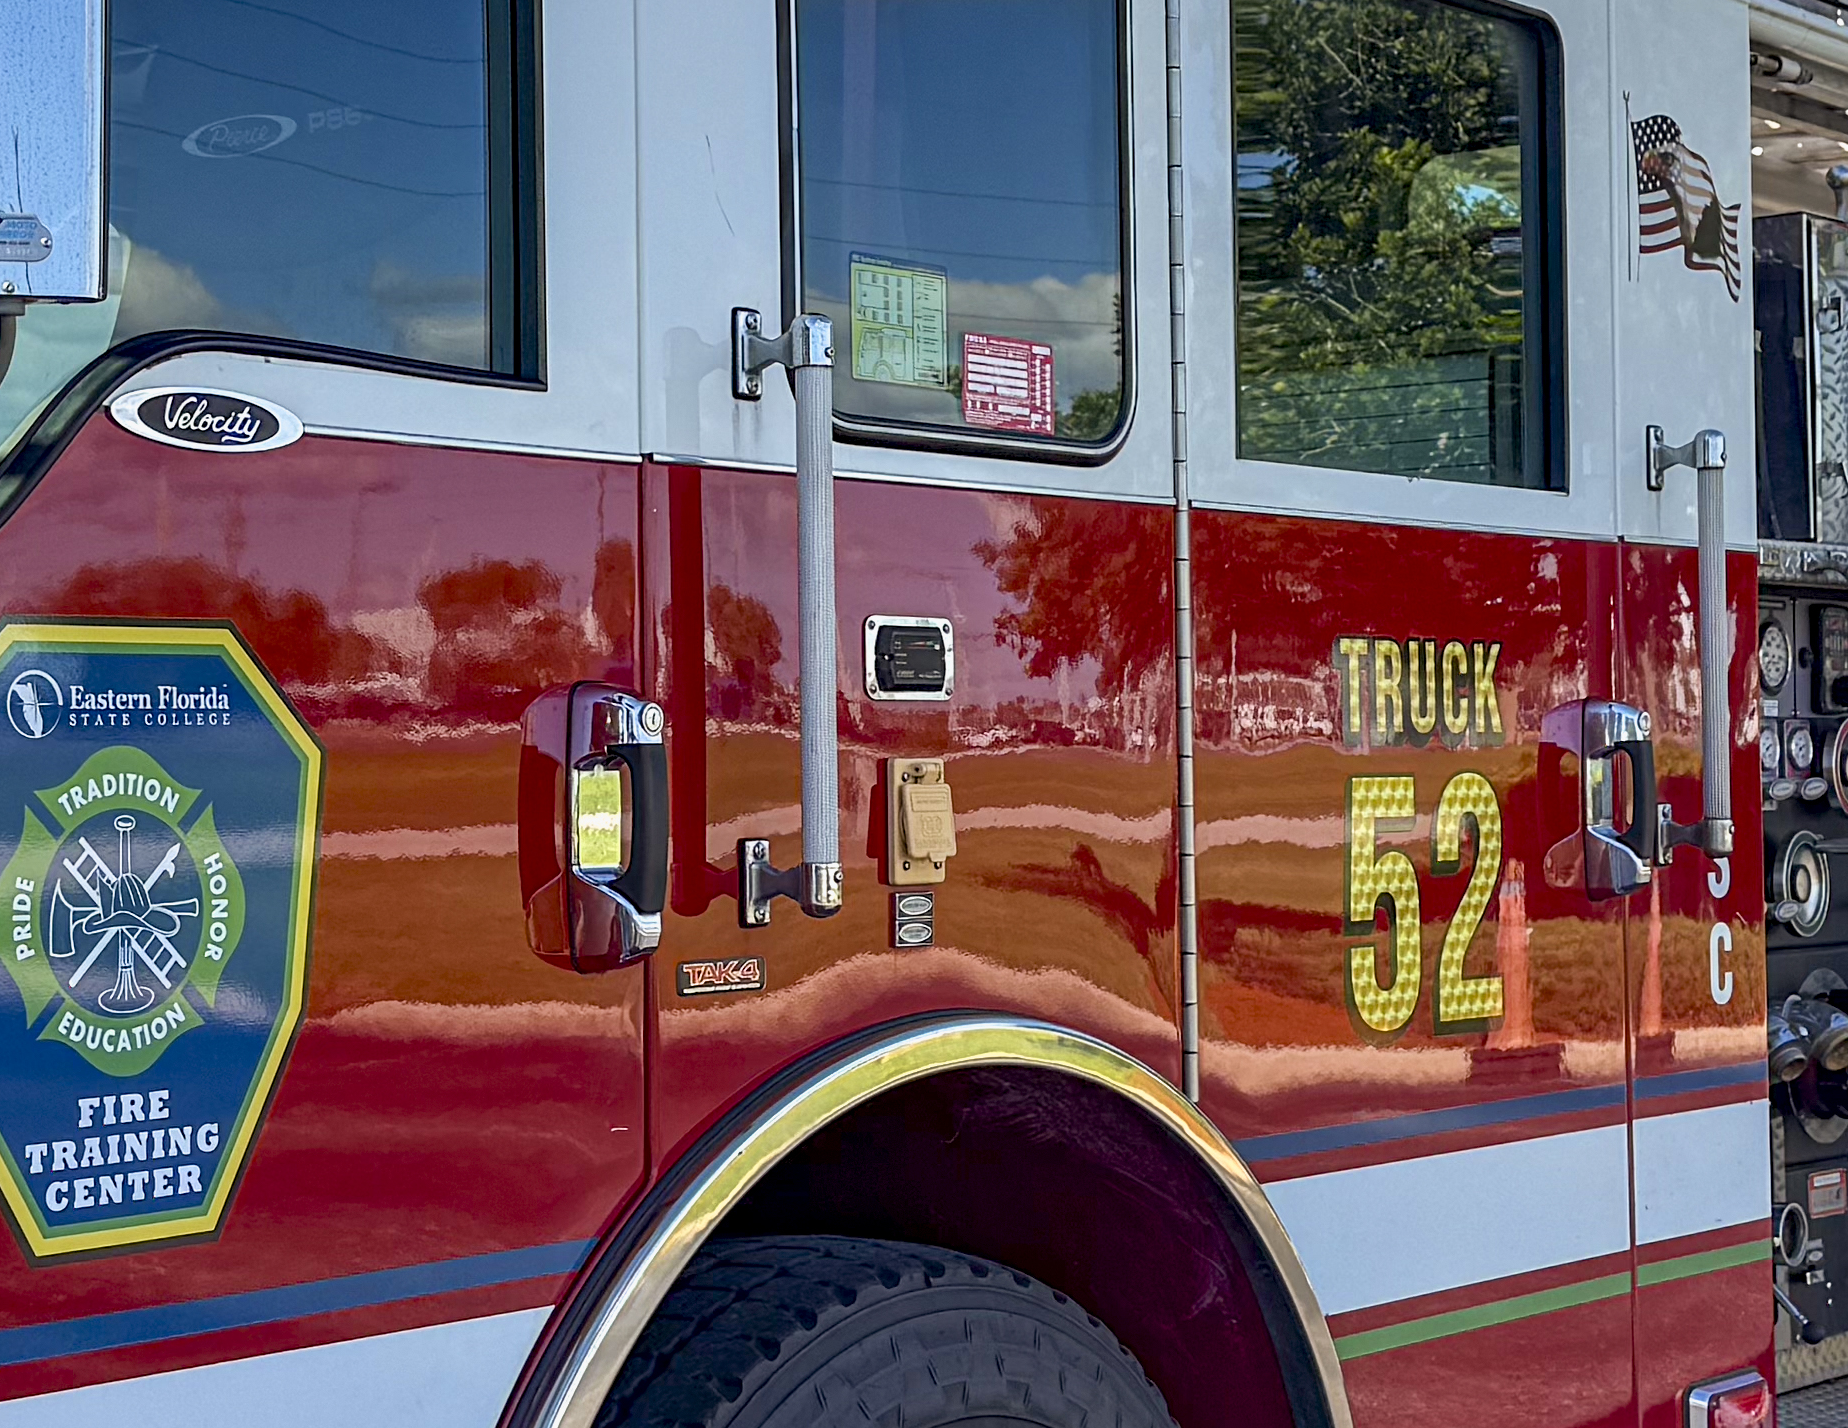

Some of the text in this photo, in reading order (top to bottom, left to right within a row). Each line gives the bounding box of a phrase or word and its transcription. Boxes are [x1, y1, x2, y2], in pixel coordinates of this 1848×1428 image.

[164, 395, 261, 443] Velocity
[69, 684, 230, 711] Eastern Florida
[1338, 637, 1504, 736] TRUCK
[69, 712, 231, 726] STATE COLLEGE
[58, 772, 180, 815] TRADITION
[12, 876, 35, 961] PRIDE
[203, 853, 228, 962] HONOR
[1350, 771, 1504, 1033] 52
[682, 959, 760, 987] TAK-4
[58, 1002, 187, 1053] EDUCATION
[77, 1089, 171, 1129] FIRE
[24, 1121, 221, 1174] TRAINING
[45, 1164, 203, 1212] CENTER
